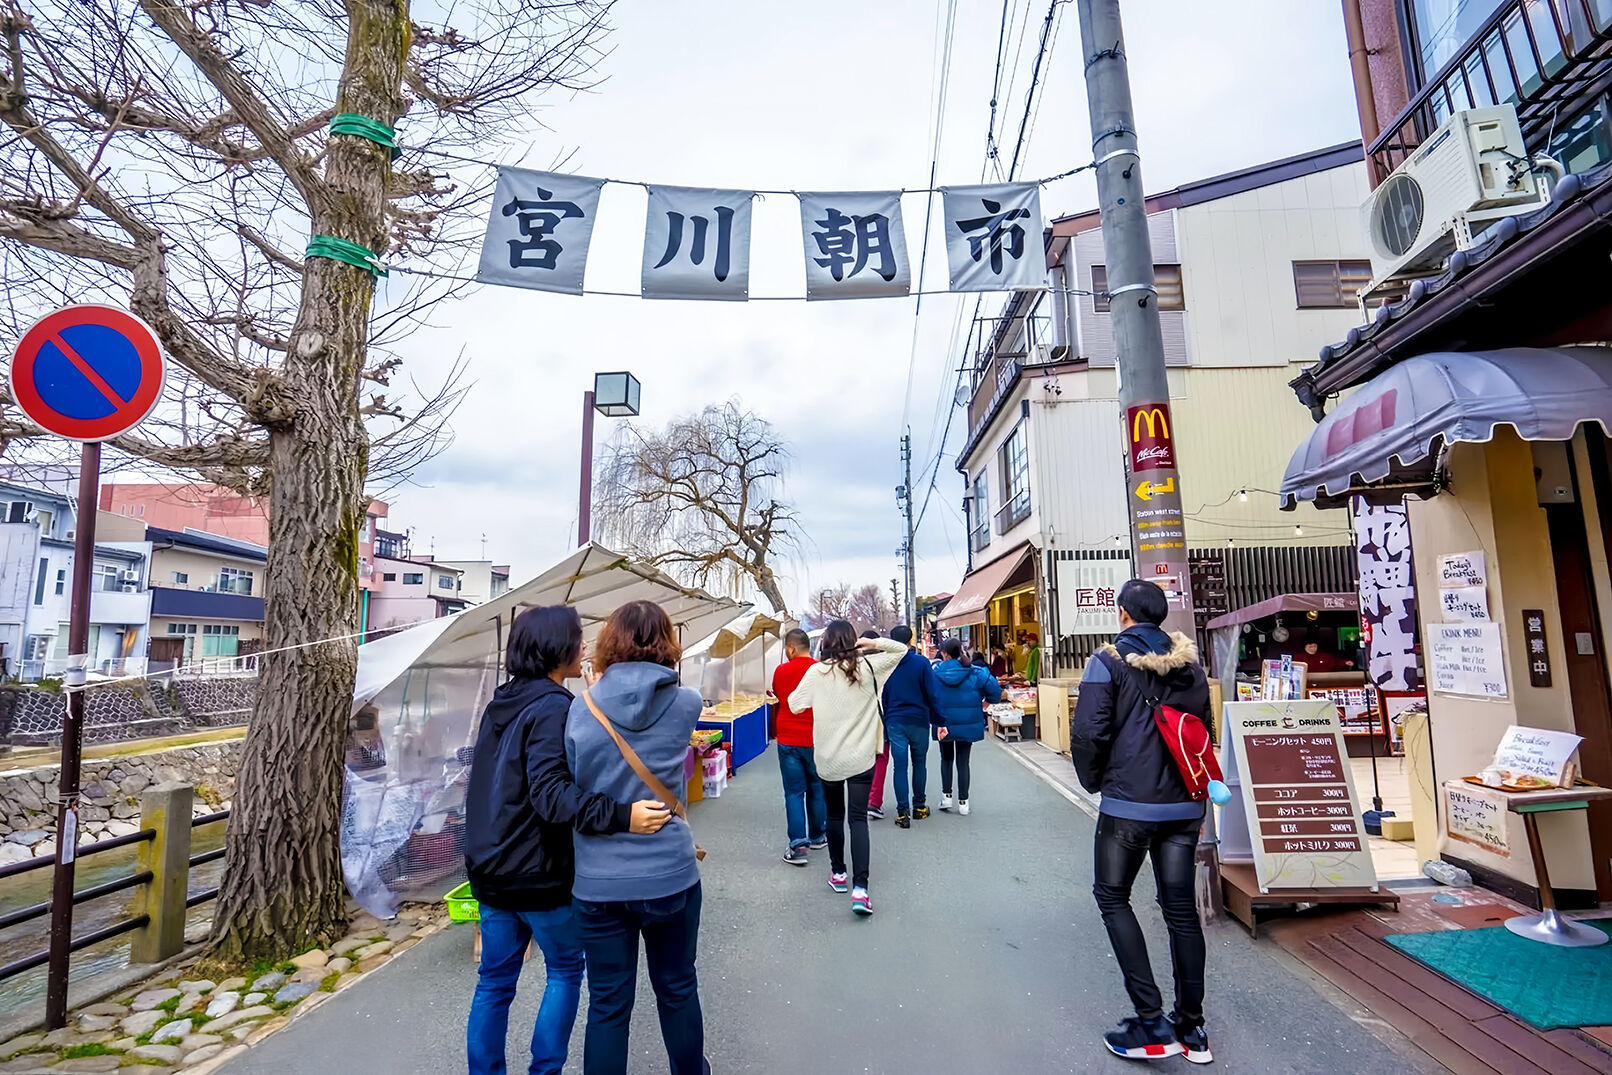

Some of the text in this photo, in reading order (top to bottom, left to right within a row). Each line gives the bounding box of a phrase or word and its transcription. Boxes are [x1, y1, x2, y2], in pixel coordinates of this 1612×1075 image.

[502, 186, 1031, 283] 宮川朝市
[1076, 587, 1115, 607] 匠館
[1528, 616, 1547, 675] 営業中
[1242, 720, 1278, 728] COFFEE
[1311, 737, 1333, 745] 450円
[1274, 789, 1344, 798] ココア 300円
[1277, 806, 1348, 816] ホットコーヒー 300円
[1330, 823, 1352, 832] 300円
[1284, 840, 1356, 850] ホットミルク 300円
